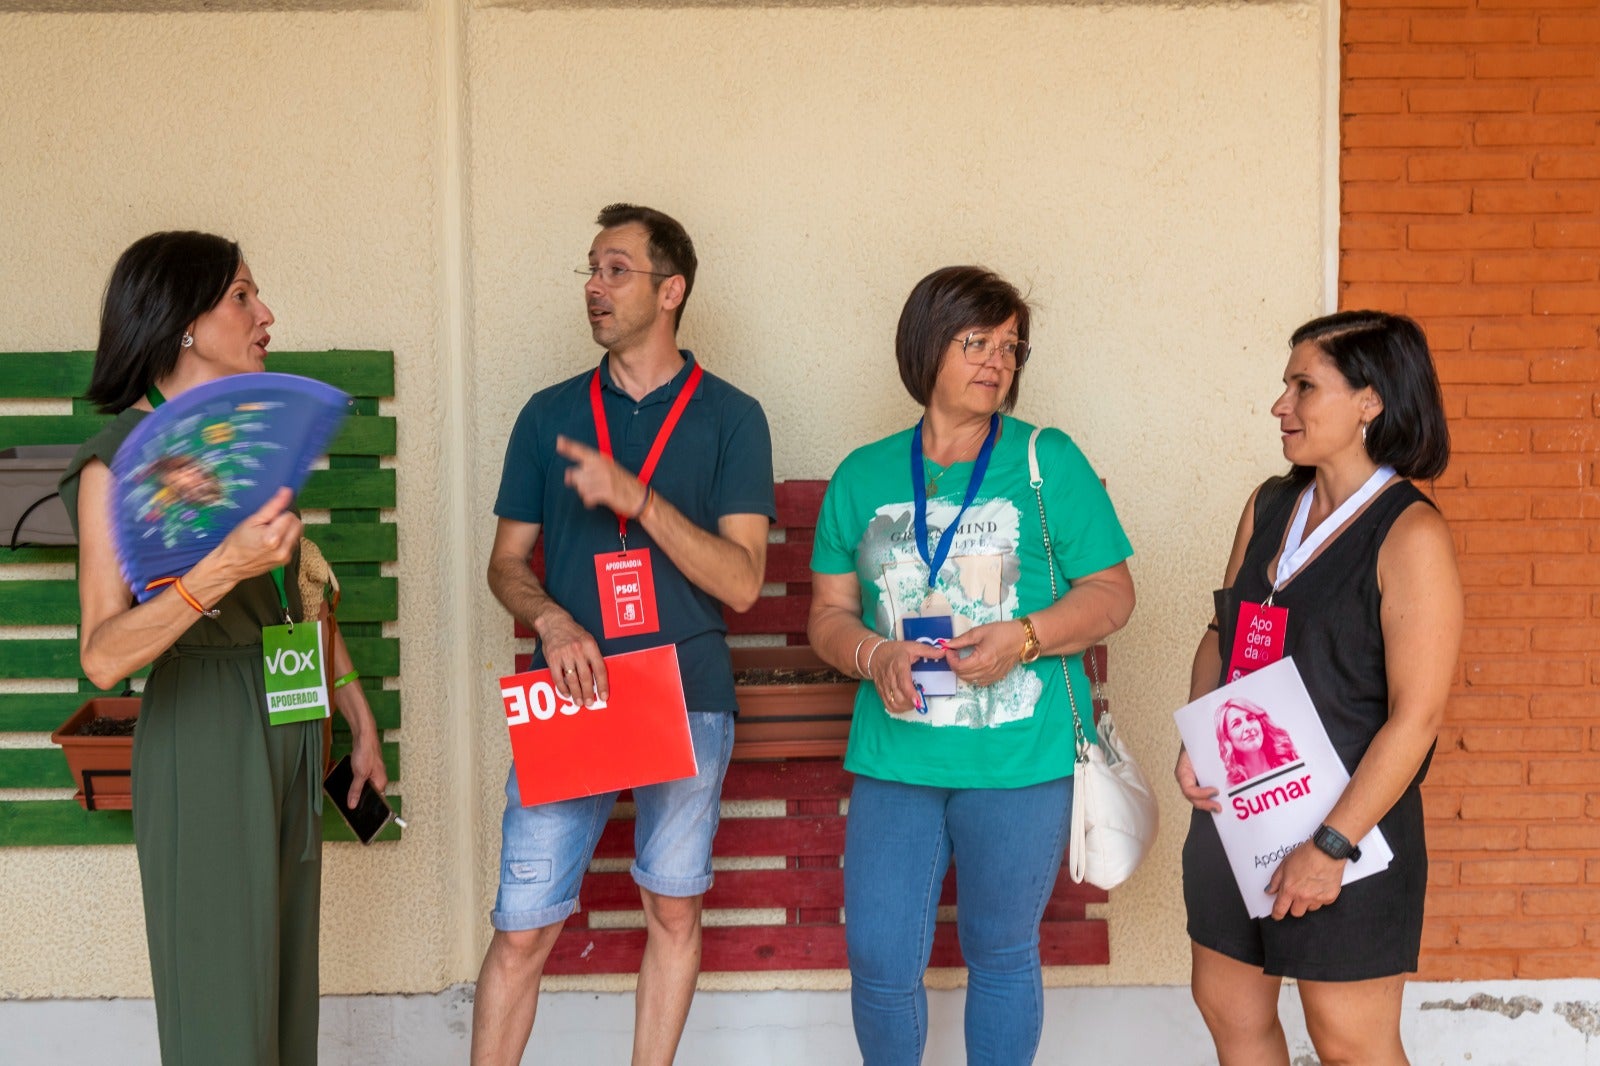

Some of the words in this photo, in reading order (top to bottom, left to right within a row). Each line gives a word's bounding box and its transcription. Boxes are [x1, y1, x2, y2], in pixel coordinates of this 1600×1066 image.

[890, 527, 943, 542] GRN
[955, 520, 997, 535] MIND
[616, 583, 638, 595] PSOE
[1250, 615, 1273, 632] Apo
[1247, 630, 1271, 647] dera
[265, 648, 315, 676] VOX
[271, 691, 318, 709] APODERADO
[1232, 774, 1312, 820] Sumar
